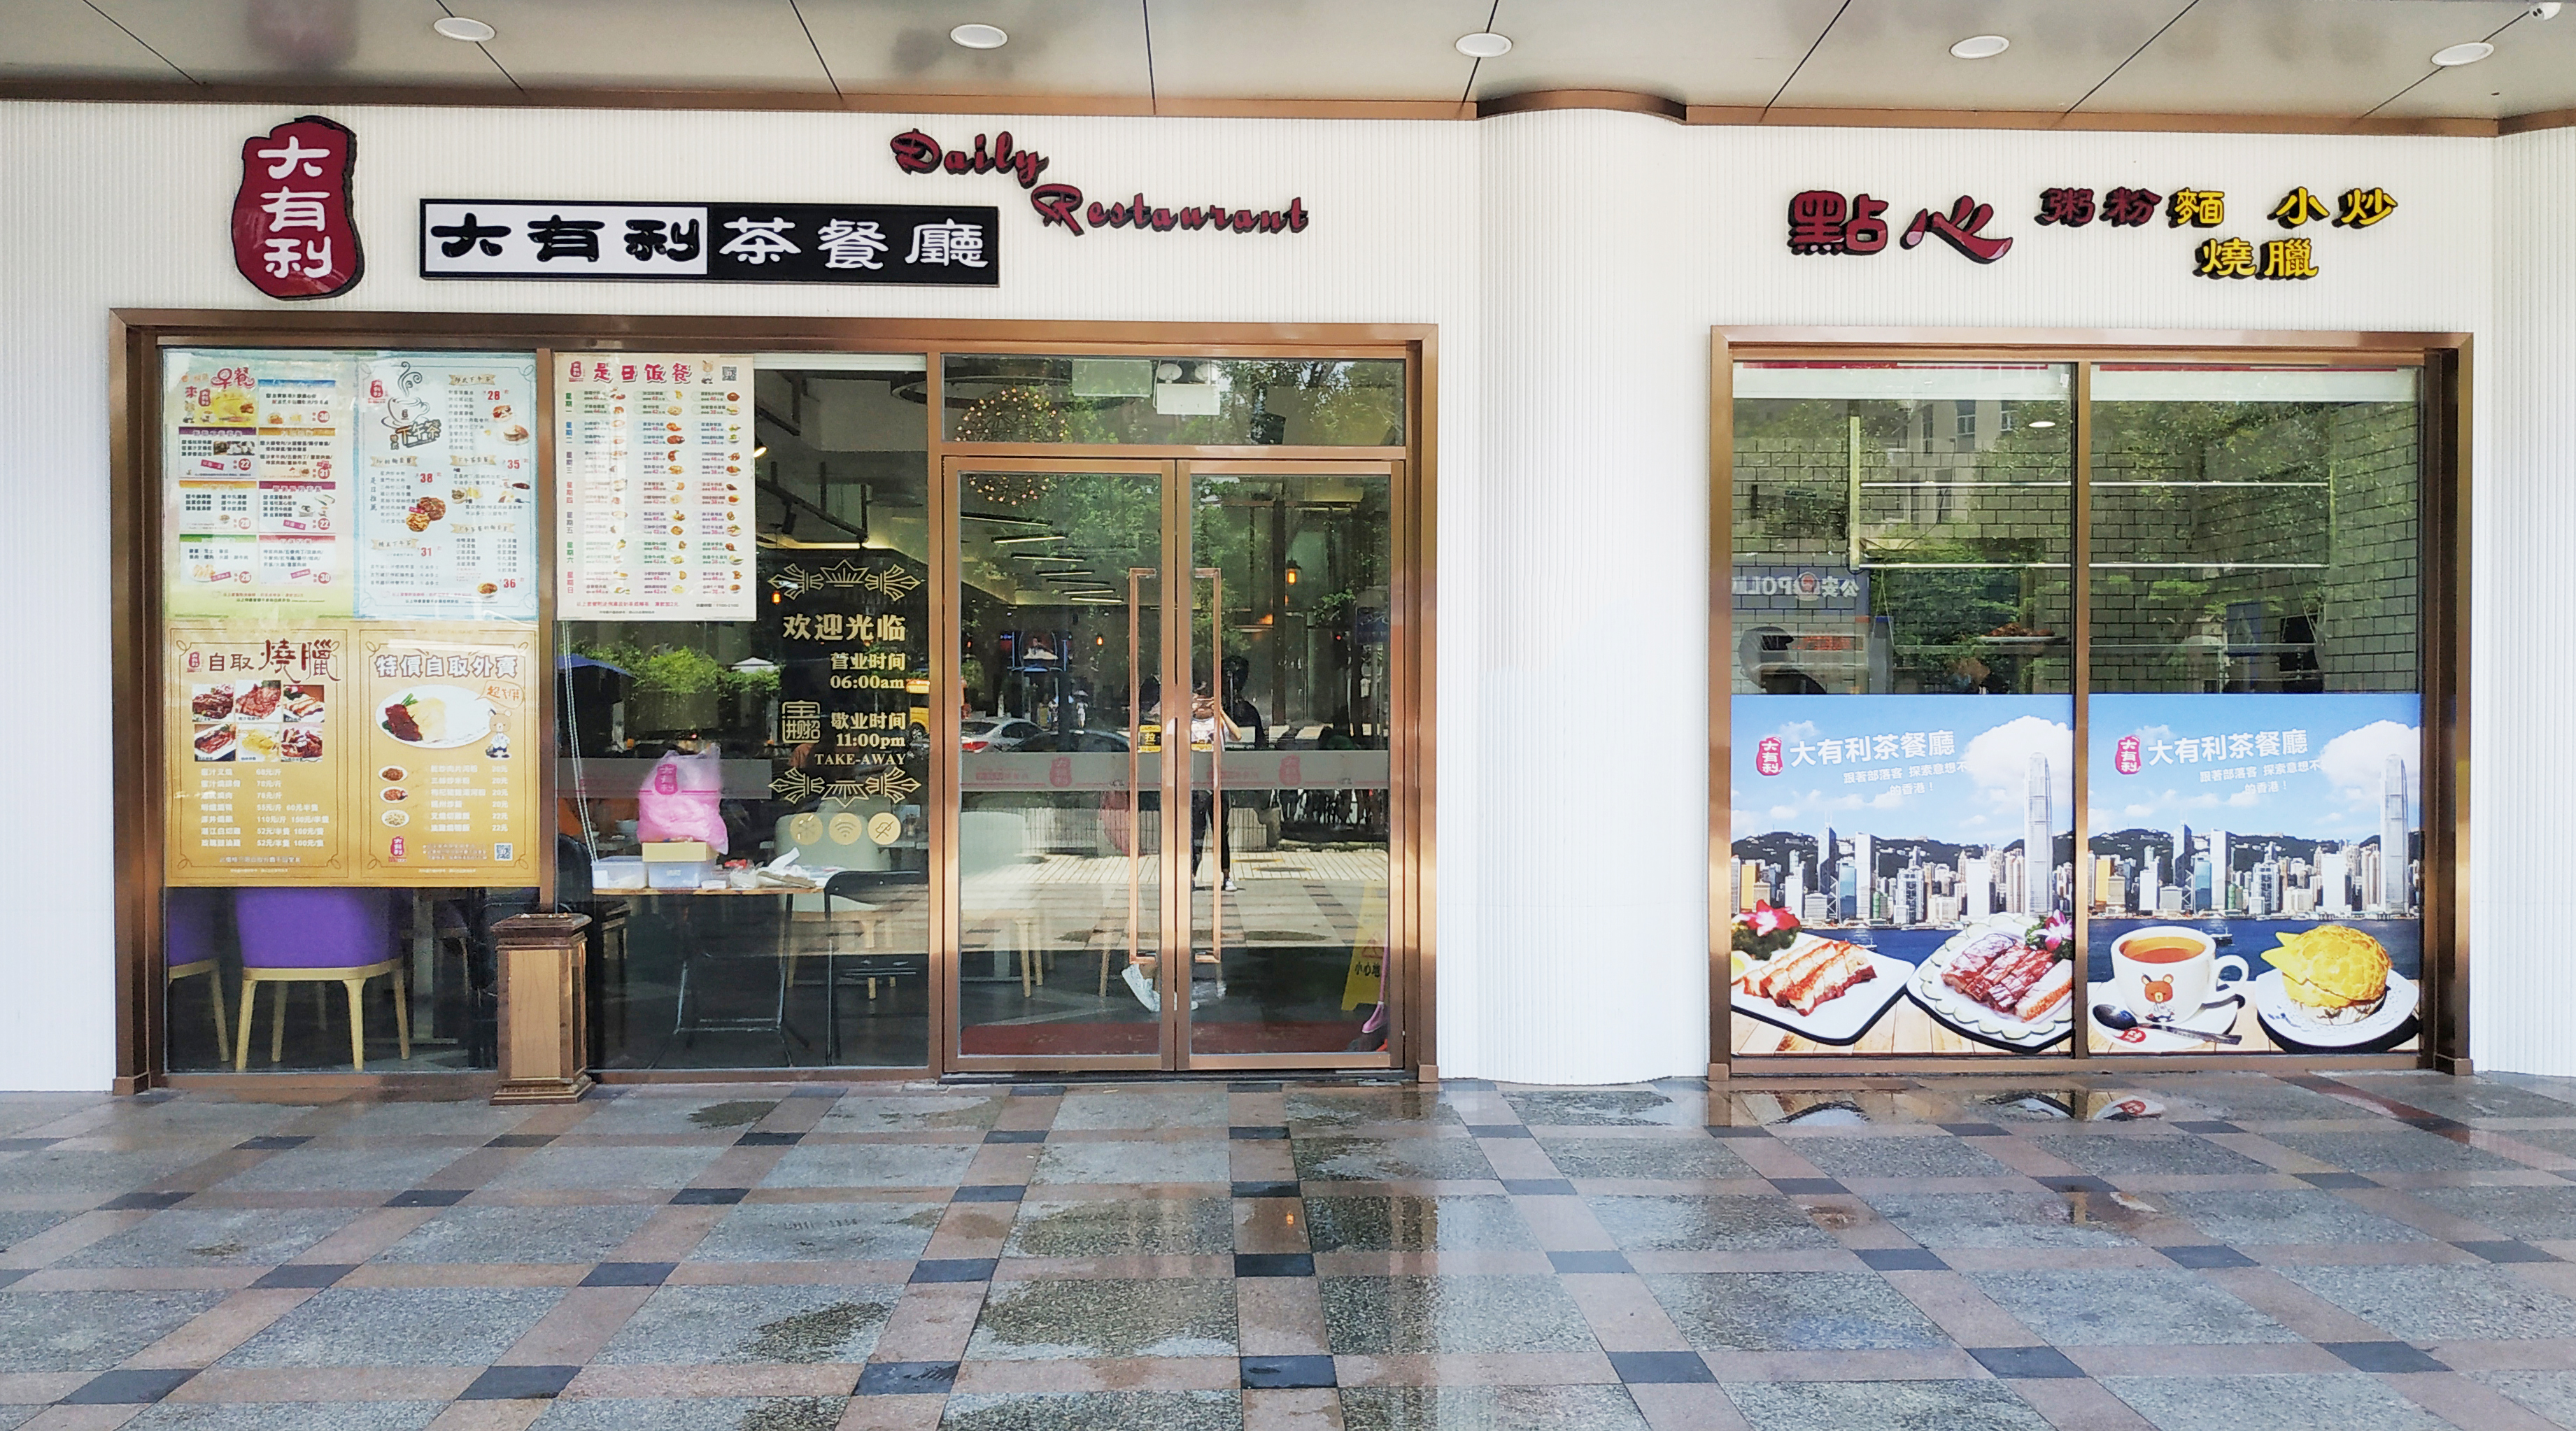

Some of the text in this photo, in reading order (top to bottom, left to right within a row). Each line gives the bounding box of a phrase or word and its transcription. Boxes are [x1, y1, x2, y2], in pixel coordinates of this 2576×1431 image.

[890, 129, 1049, 187] Daily
[257, 136, 332, 279] 大有利
[1031, 183, 1308, 236] Restaurant
[2033, 186, 2398, 229] 粥粉麵 小炒
[1788, 189, 2013, 264] 點心
[430, 213, 989, 271] 大有利茶餐廳
[2194, 238, 2319, 280] 燒臘
[211, 367, 255, 390] 早餐
[488, 390, 500, 400] 28
[395, 419, 441, 446] 下午茶
[240, 460, 250, 469] 22
[507, 460, 521, 469] 35
[420, 474, 433, 483] 38
[320, 520, 330, 529] 22
[420, 548, 432, 557] 31
[241, 574, 250, 582] 26
[503, 579, 516, 588] 36
[783, 614, 906, 641] 欢迎光临
[375, 654, 518, 679] 特價自取外賣
[830, 653, 906, 671] 营业时间
[830, 675, 905, 690] 06:00am
[831, 712, 906, 731] 歇业时间
[836, 733, 906, 748] 11:00pm
[1145, 732, 1156, 742] 拉
[1761, 739, 1781, 774] 大有利
[1790, 729, 1955, 768] 大有利茶餐廳
[2120, 739, 2139, 773] 大有利
[2148, 729, 2308, 766] 大有利茶餐廳
[814, 753, 906, 766] TAKE-AWAY
[1843, 766, 1903, 784] 跟著部落客
[2200, 765, 2258, 783] 跟著部落客
